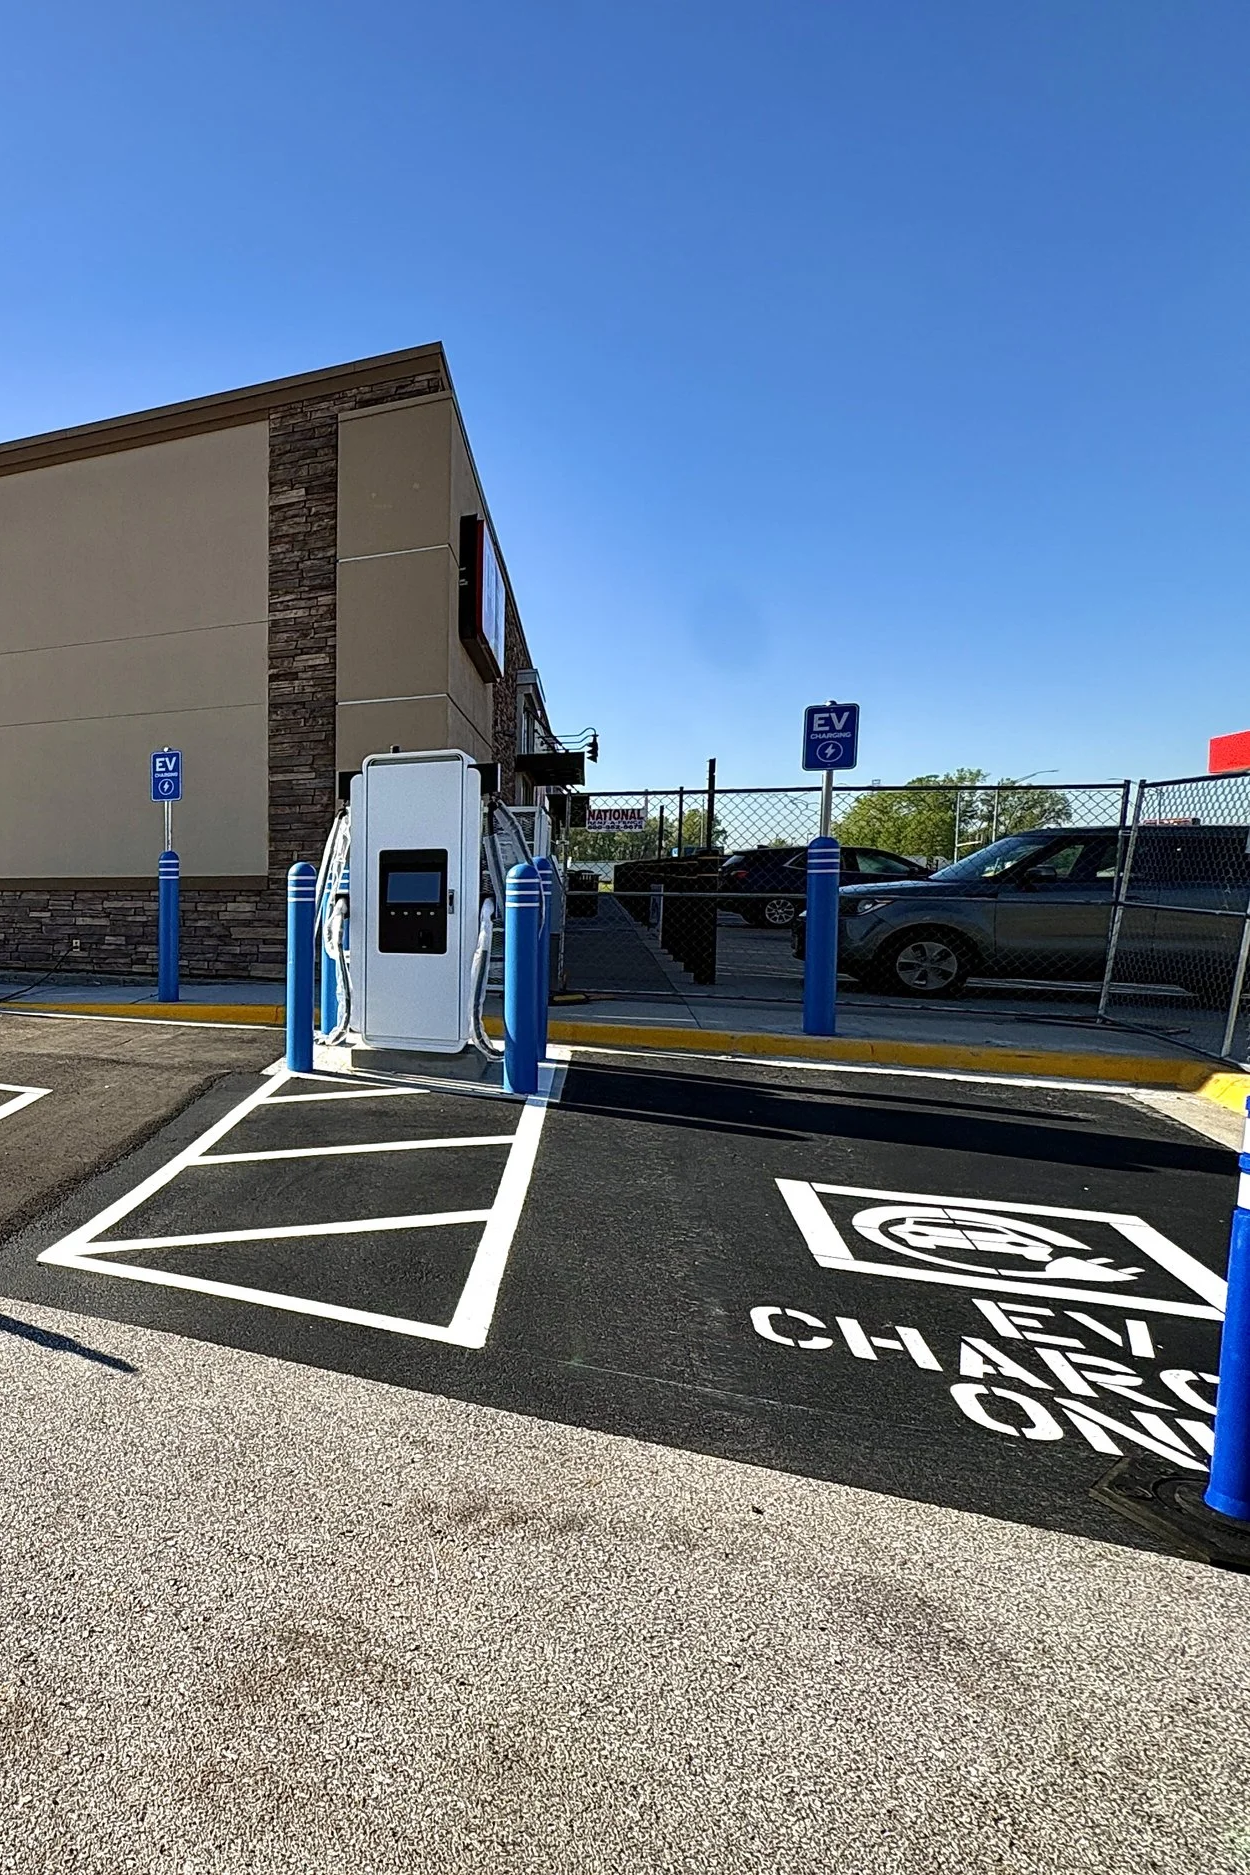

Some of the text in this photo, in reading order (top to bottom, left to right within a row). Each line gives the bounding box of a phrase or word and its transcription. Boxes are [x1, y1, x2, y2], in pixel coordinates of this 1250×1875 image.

[813, 711, 850, 732] EV
[810, 731, 852, 740] CHARGING
[155, 756, 177, 772] EV
[587, 808, 645, 821] NATIONAL
[971, 1297, 1157, 1359] EV
